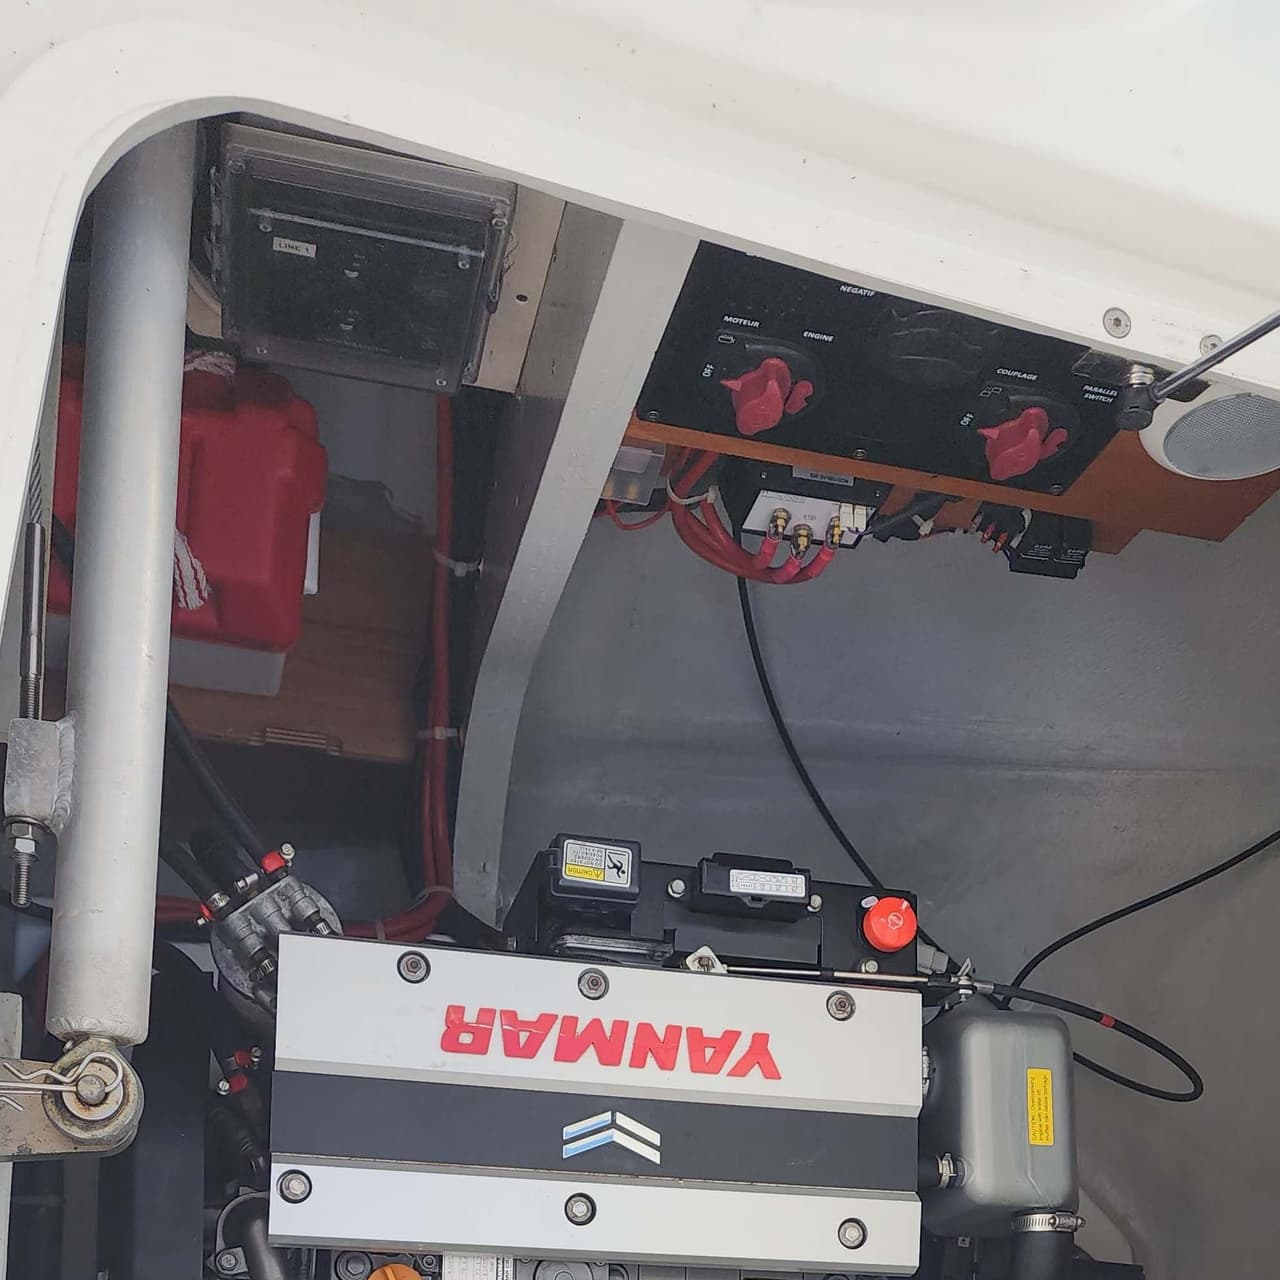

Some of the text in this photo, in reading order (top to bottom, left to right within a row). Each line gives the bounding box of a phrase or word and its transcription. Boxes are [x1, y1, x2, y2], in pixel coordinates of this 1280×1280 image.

[840, 284, 876, 297] NEGATIF
[723, 315, 760, 328] MOTEUR
[803, 331, 835, 342] ENGINE
[702, 363, 716, 377] OFF
[996, 368, 1039, 381] COUPLAGE
[1082, 385, 1118, 397] PARALLEL
[1084, 393, 1114, 404] SWITCH
[960, 413, 974, 426] OFF
[441, 1005, 782, 1080] YANMAR
